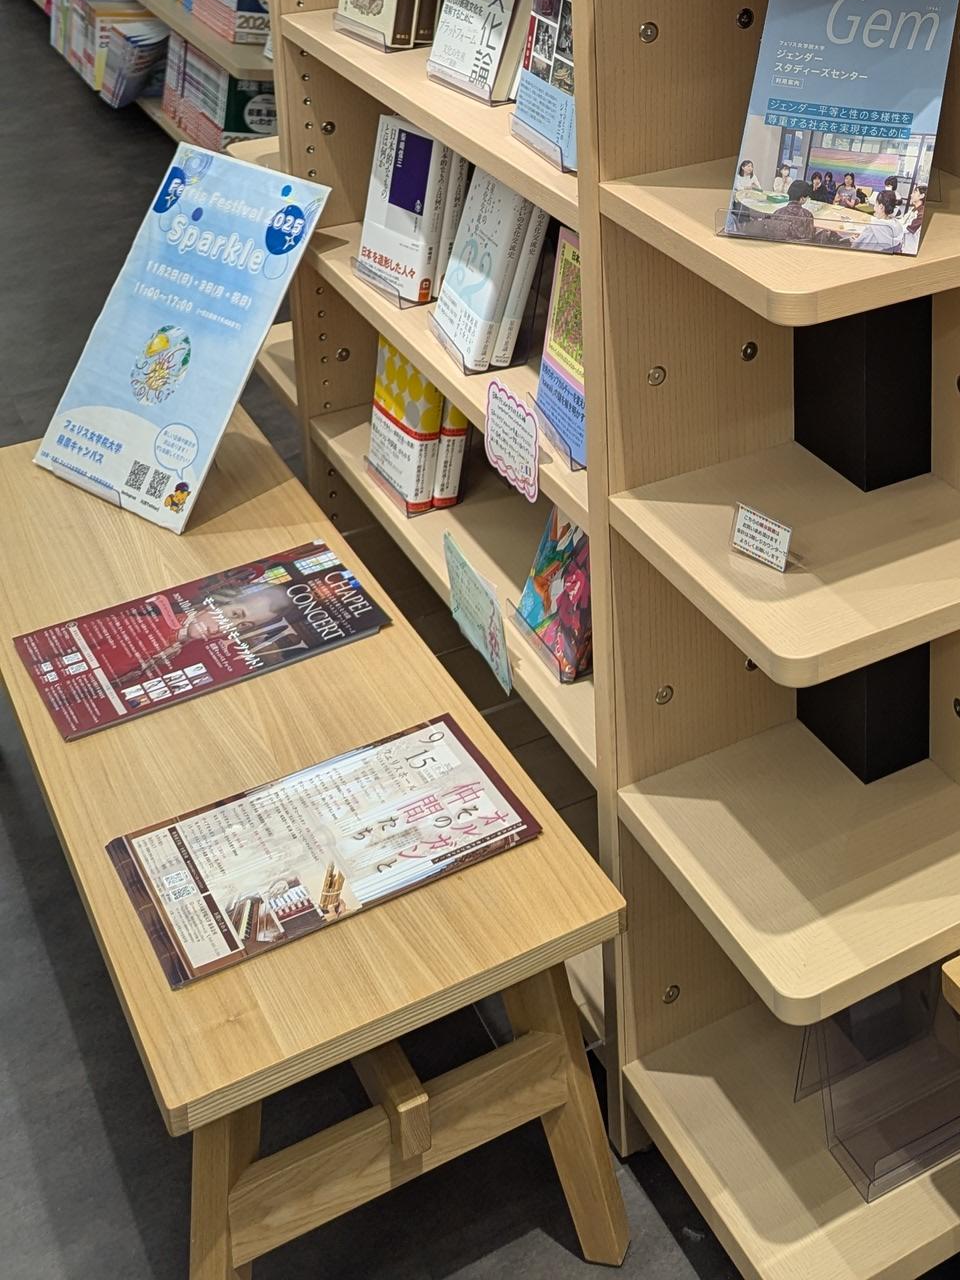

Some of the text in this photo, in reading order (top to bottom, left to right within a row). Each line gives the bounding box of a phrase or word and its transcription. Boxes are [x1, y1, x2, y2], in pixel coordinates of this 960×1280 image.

[776, 49, 823, 62] ジェンダー
[774, 63, 868, 81] スタディーズセンター
[770, 99, 911, 124] ジェンダー平等と性の多様性を
[768, 116, 908, 138] 尊重する社会を実現するために
[266, 207, 306, 236] 2025
[166, 217, 268, 275] Sparkle
[361, 246, 416, 279] 日本を造形した人々
[56, 433, 105, 465] 緑園キャンパス
[63, 418, 124, 455] フェリス女学院大学
[325, 571, 372, 618] CHAPEL
[286, 584, 345, 641] CONCERT
[404, 748, 436, 770] 15
